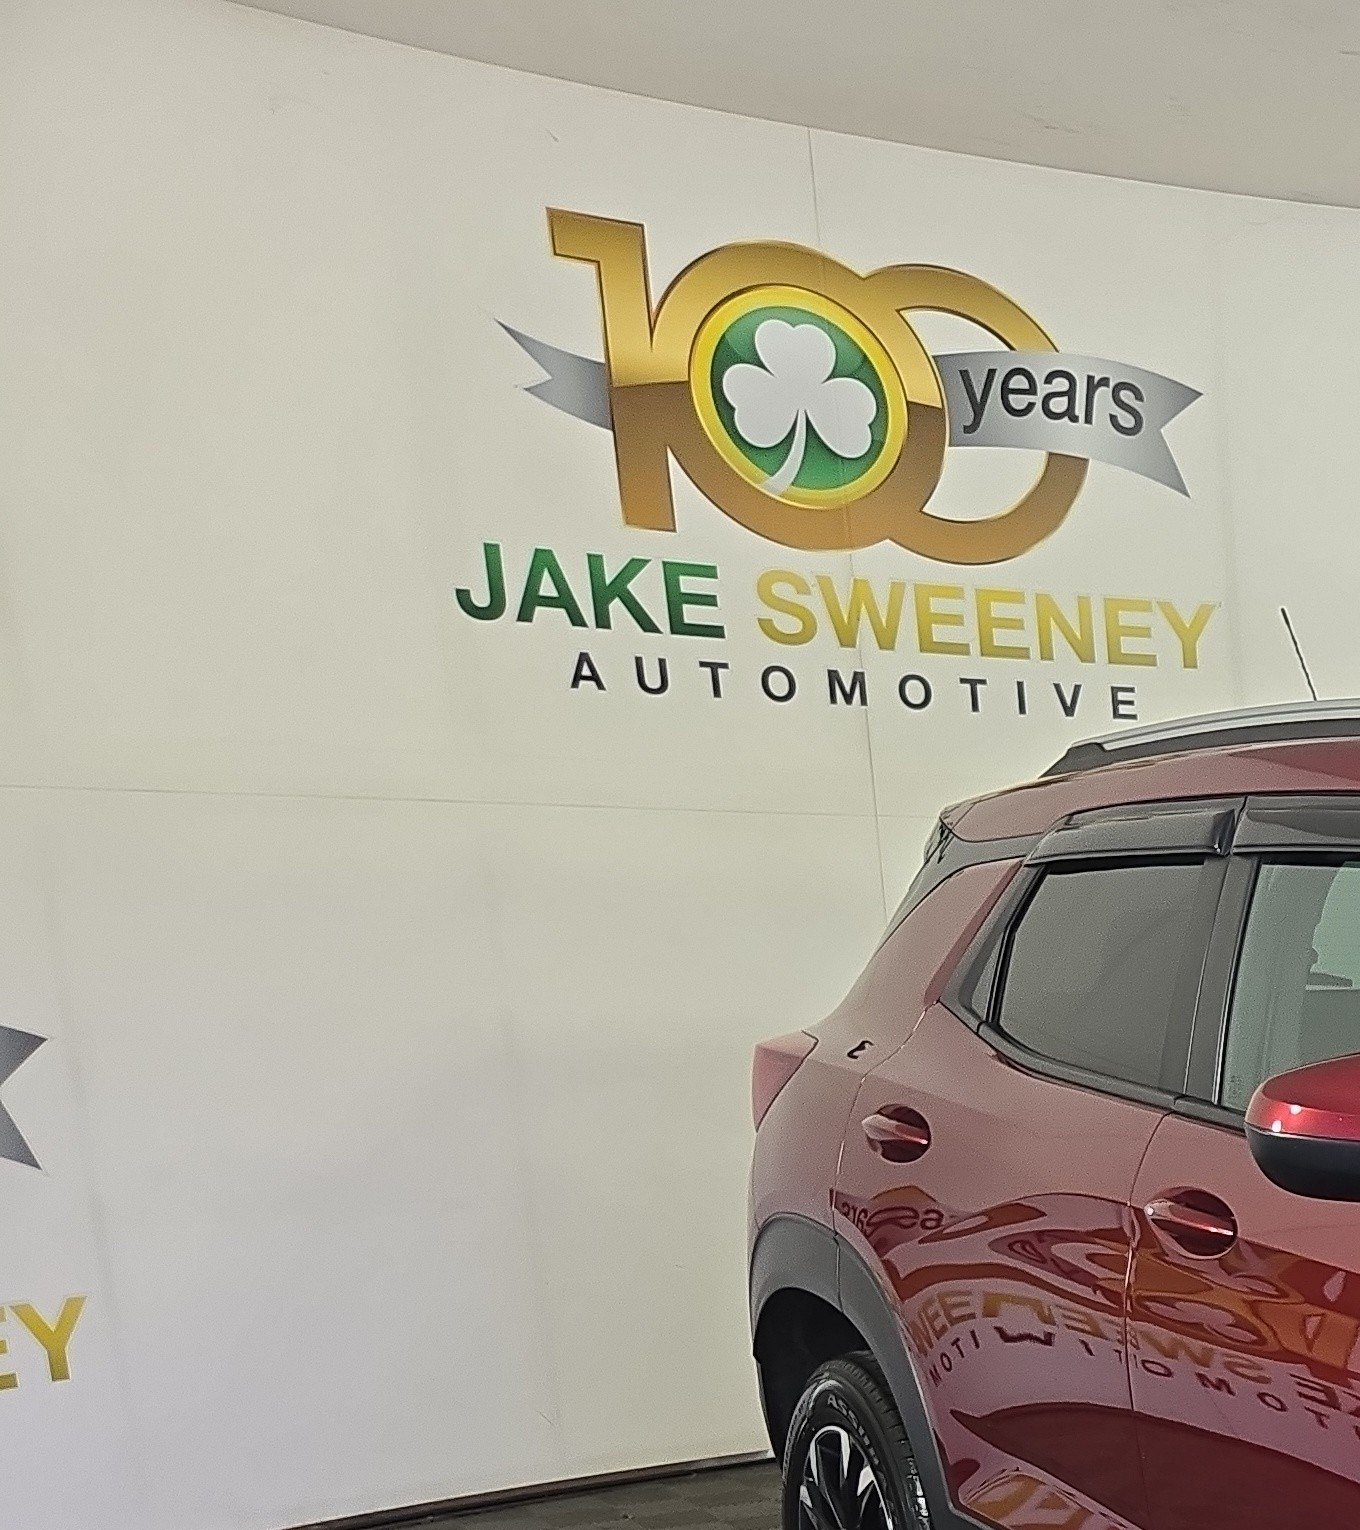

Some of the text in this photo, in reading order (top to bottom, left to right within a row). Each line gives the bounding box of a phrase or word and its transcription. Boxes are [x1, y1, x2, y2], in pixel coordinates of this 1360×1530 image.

[960, 364, 1144, 436] years
[455, 541, 1223, 671] JAKE SWEENEY
[570, 651, 1139, 720] AUTOMOTIVE
